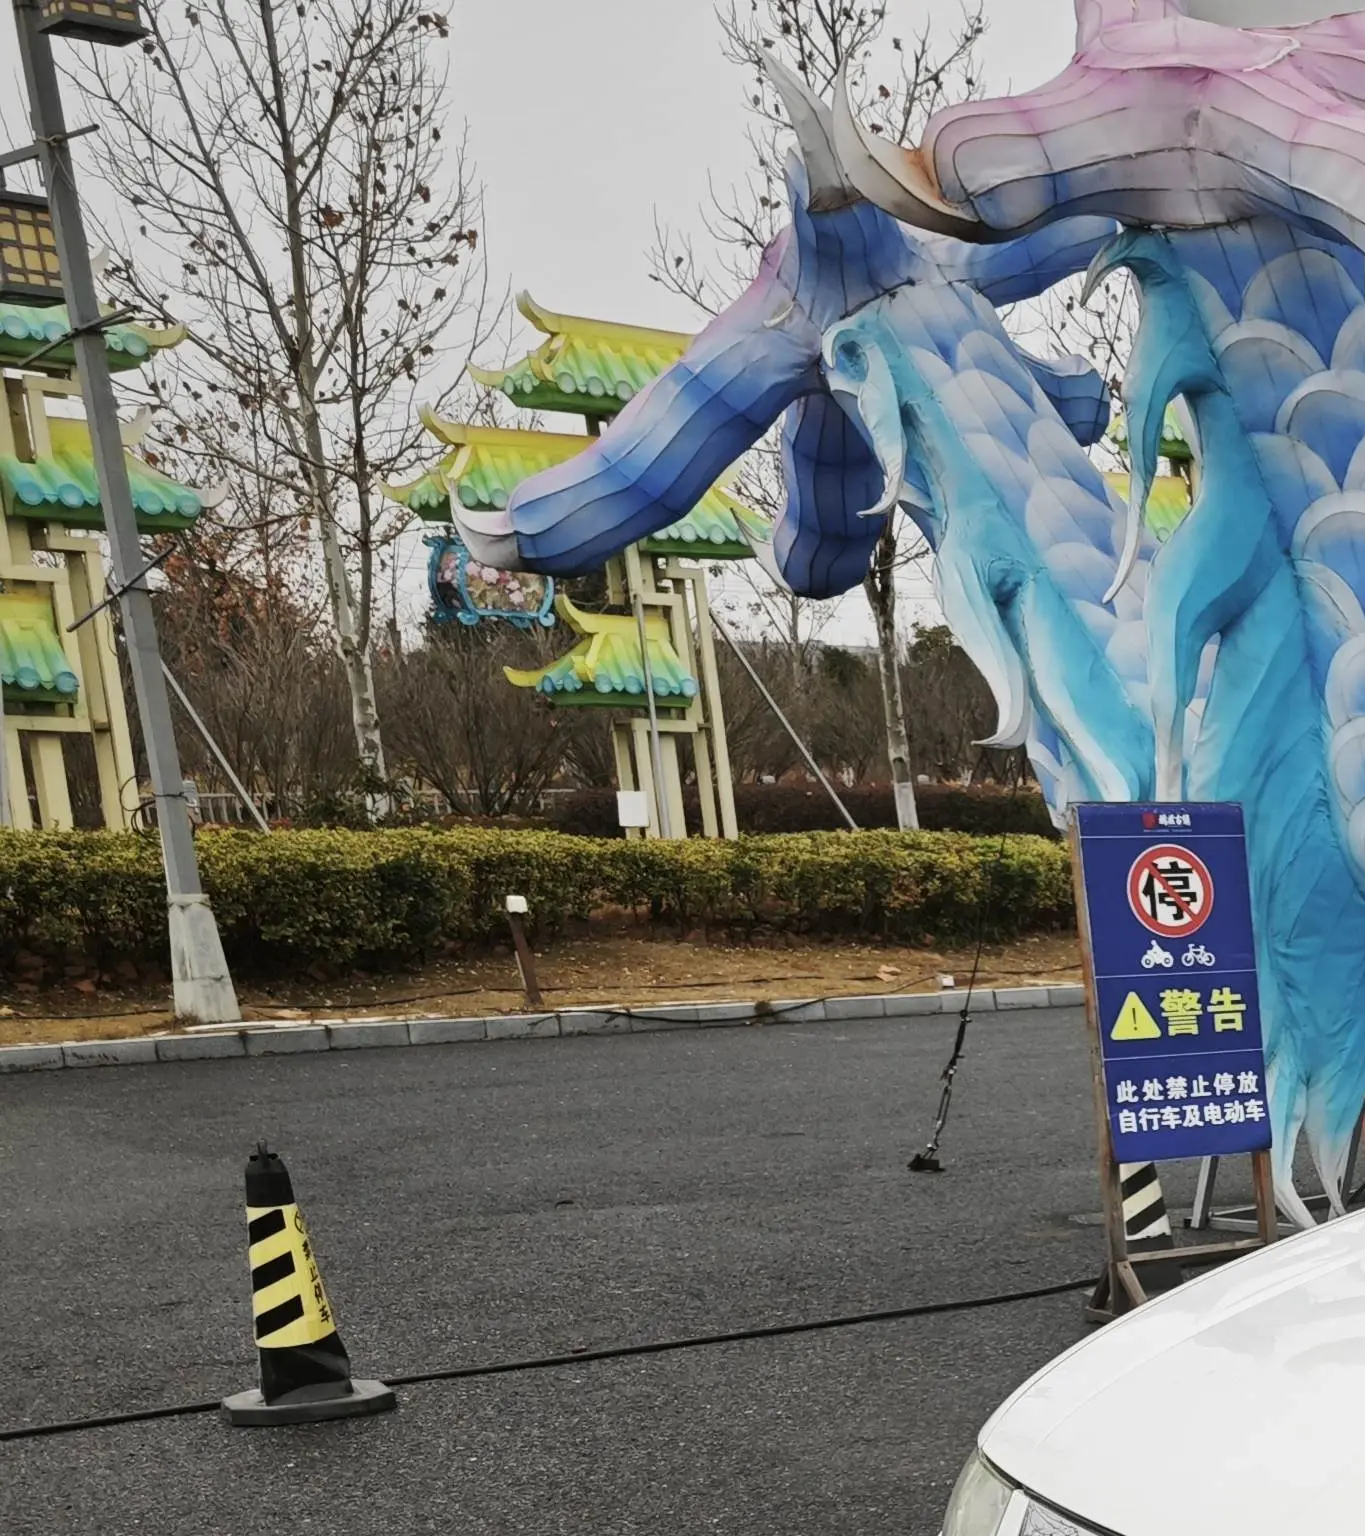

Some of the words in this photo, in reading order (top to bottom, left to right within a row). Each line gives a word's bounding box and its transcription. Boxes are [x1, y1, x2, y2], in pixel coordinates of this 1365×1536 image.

[1142, 861, 1197, 921] 停
[1159, 987, 1247, 1036] 警告
[1116, 1070, 1259, 1103] 此处禁止停放
[1118, 1099, 1266, 1134] 自行车及电动车
